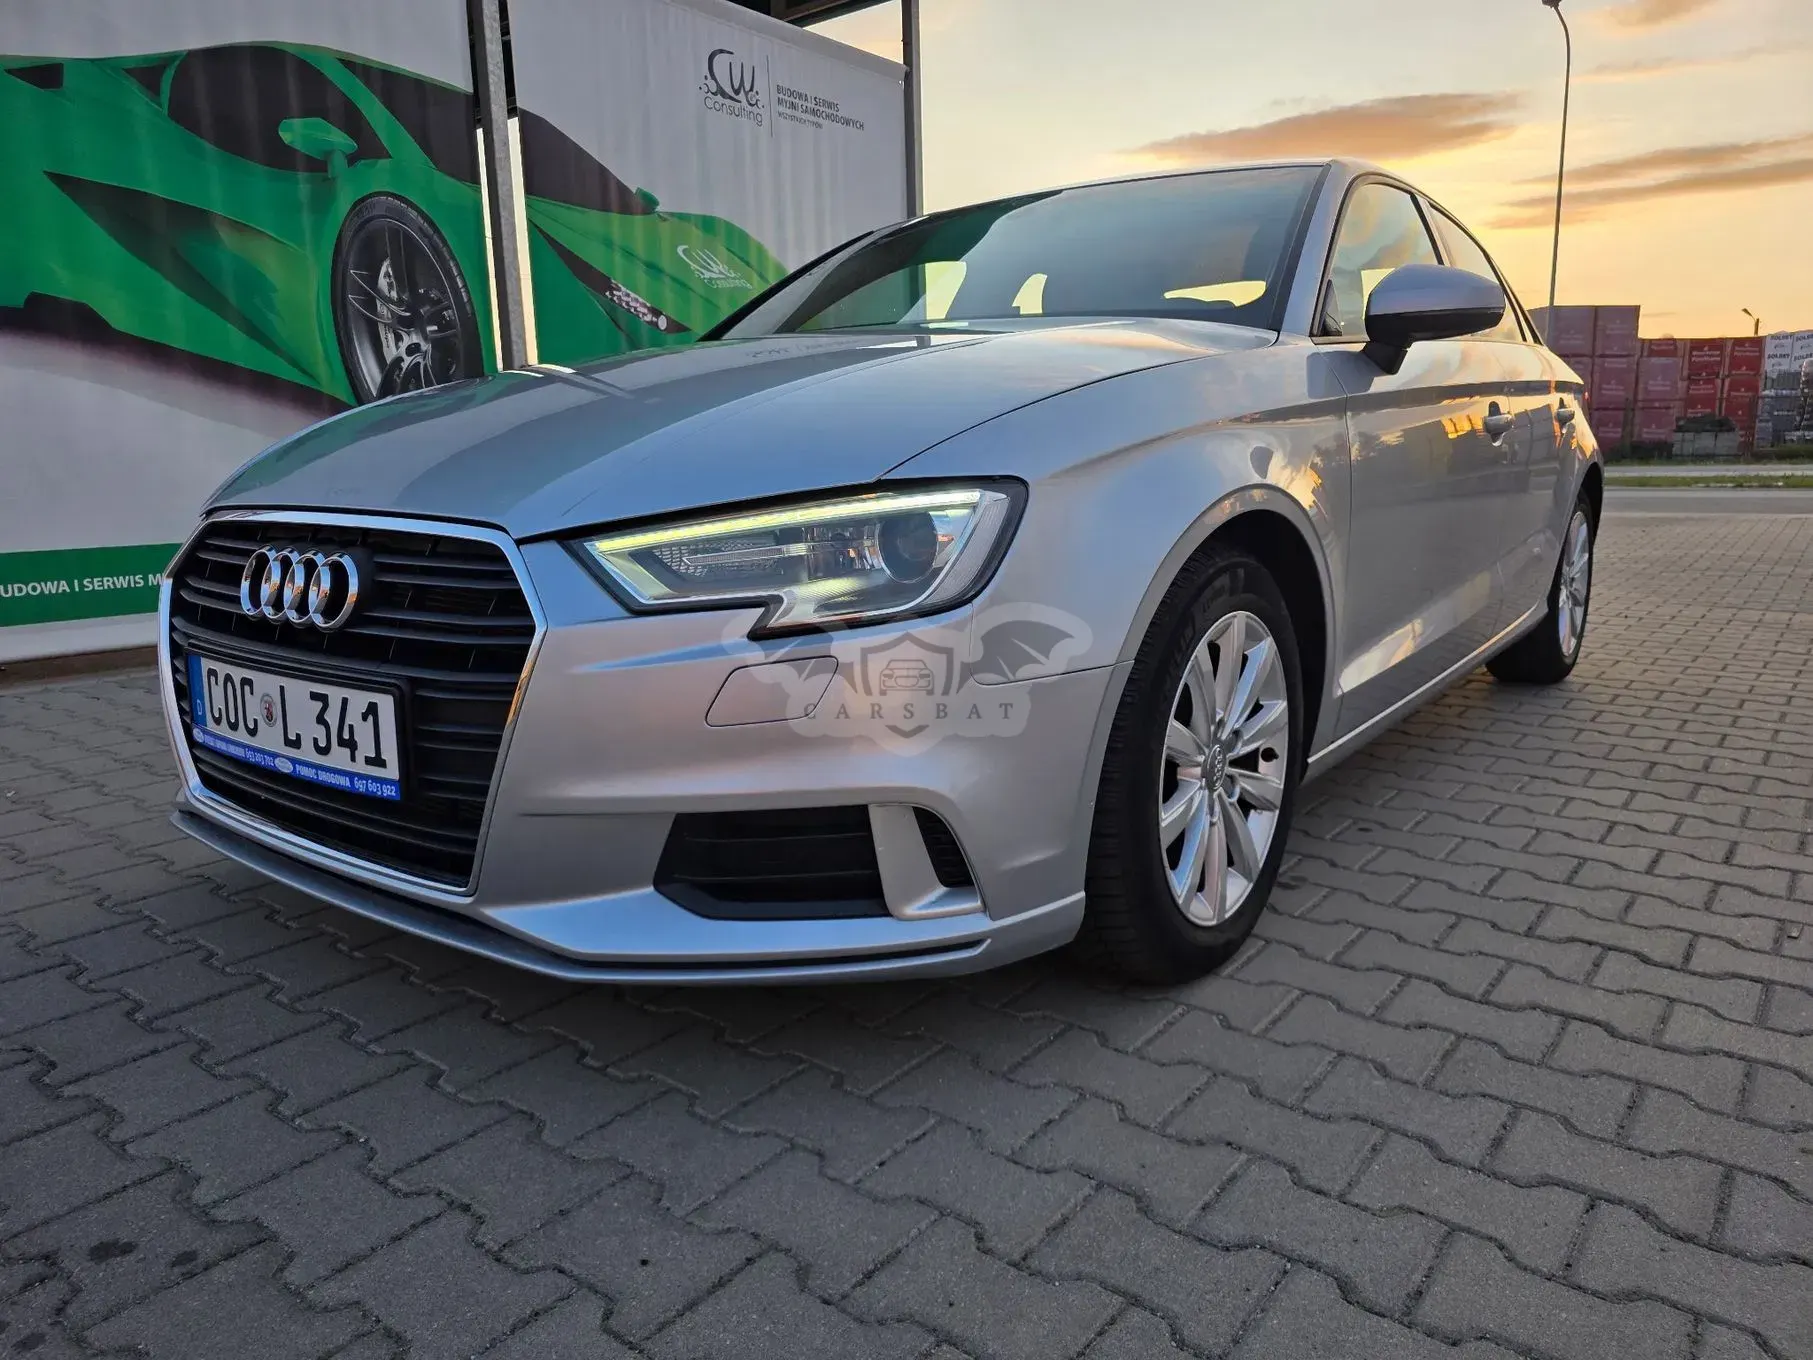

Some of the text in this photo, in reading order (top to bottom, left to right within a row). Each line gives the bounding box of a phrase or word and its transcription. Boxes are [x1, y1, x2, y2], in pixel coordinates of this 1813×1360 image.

[703, 96, 763, 126] Consulting
[776, 84, 809, 103] BUDOWA
[814, 96, 840, 112] SERWIS
[777, 97, 865, 131] MYJNI SAMOCHODOWYCH
[74, 579, 79, 592] I
[83, 574, 144, 592] SERWIS
[148, 572, 165, 586] M
[196, 699, 203, 715] D
[206, 667, 388, 769] COC L 341
[295, 764, 318, 779] POMOC
[317, 769, 351, 788] DROGOWA
[354, 776, 367, 793] 697
[367, 780, 382, 795] 603
[382, 784, 396, 796] 922
